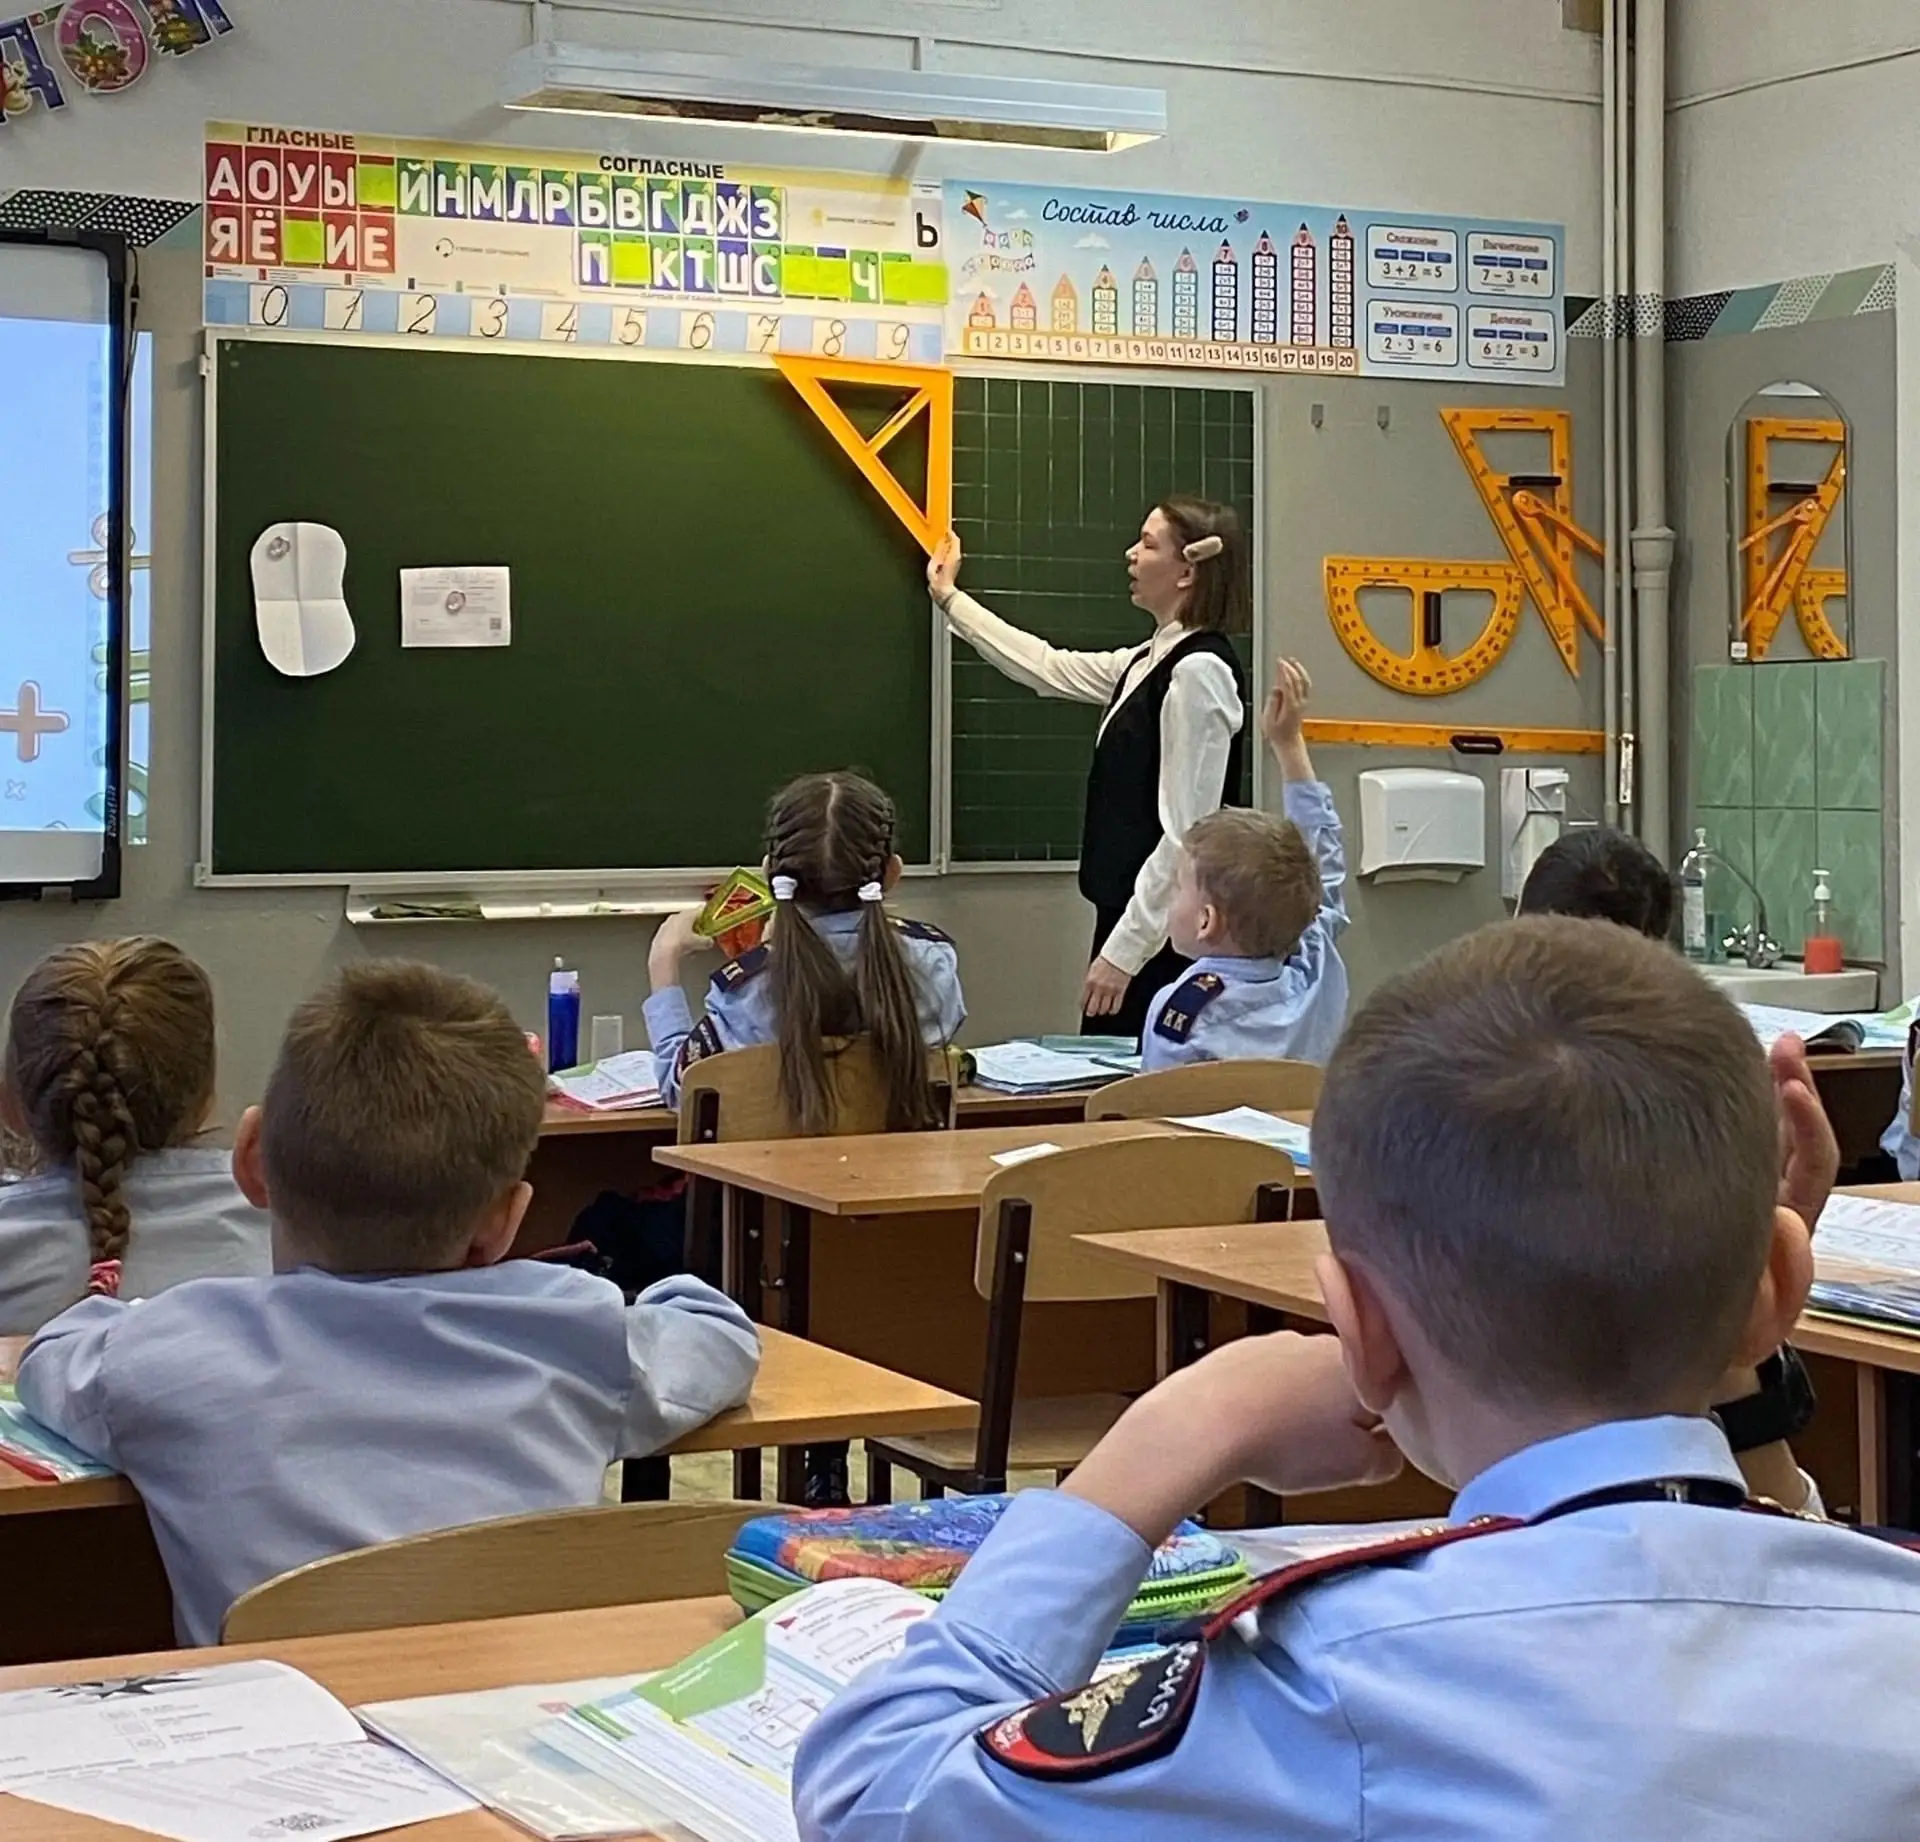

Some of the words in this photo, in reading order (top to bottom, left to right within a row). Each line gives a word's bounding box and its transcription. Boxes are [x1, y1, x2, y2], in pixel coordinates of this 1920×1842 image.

[247, 126, 355, 150] ГЛАСНЫЕ
[209, 157, 241, 199] А
[248, 160, 278, 201] О
[287, 162, 316, 204] У
[323, 165, 355, 207] Ы
[599, 155, 724, 179] СОГЛАСНЫЕ
[399, 163, 428, 212] Й
[437, 174, 465, 215] Н
[472, 176, 502, 218] М
[507, 180, 537, 220] Л
[545, 182, 571, 222] Р
[579, 185, 608, 226] Б
[615, 188, 642, 228] В
[651, 191, 674, 230] Г
[683, 192, 714, 237] Д
[715, 195, 749, 235] Ж
[1042, 198, 1141, 227] Состав
[1147, 210, 1229, 234] числа
[210, 216, 238, 259] Я
[251, 209, 277, 260] Ё
[326, 223, 355, 266] И
[363, 226, 389, 268] Е
[582, 243, 608, 284] П
[653, 246, 679, 288] К
[685, 249, 711, 290] Т
[717, 251, 748, 292] Ш
[753, 252, 778, 295] С
[853, 257, 877, 299] Ч
[1383, 262, 1390, 275] 3
[1396, 266, 1404, 275] +
[1408, 264, 1416, 277] 2
[1422, 268, 1432, 276] =
[1434, 266, 1442, 278] 5
[1482, 269, 1489, 280] 7
[1507, 270, 1514, 283] 3
[1531, 272, 1538, 284] 4
[262, 285, 288, 326] 0
[346, 290, 364, 329] 1
[407, 294, 437, 334] 2
[480, 299, 508, 338] 3
[555, 303, 578, 341] 4
[618, 308, 647, 345] 5
[689, 312, 716, 349] 6
[757, 316, 781, 352] 7
[822, 319, 846, 357] 8
[886, 323, 909, 360] 9
[975, 336, 981, 348] 1
[995, 337, 1002, 348] 2
[1015, 337, 1022, 349] 3
[1035, 338, 1042, 349] 4
[1055, 340, 1062, 351] 5
[1075, 341, 1082, 352] 6
[1095, 342, 1102, 352] 7
[1115, 343, 1121, 353] 8
[1133, 344, 1140, 354] 9
[1150, 346, 1163, 357] 10
[1170, 347, 1181, 358] 11
[1189, 348, 1201, 359] 12
[1208, 349, 1220, 360] 13
[1227, 350, 1240, 361] 14
[1245, 351, 1259, 362] 15
[1264, 352, 1277, 364] 16
[1283, 353, 1295, 365] 17
[1302, 354, 1315, 366] 18
[1321, 355, 1334, 366] 19
[1340, 356, 1352, 367] 20
[1384, 337, 1392, 350] 2
[1407, 338, 1414, 350] 3
[1435, 340, 1442, 352] 6
[1484, 342, 1491, 354] 6
[1506, 344, 1513, 356] 2
[1532, 345, 1538, 358] 3
